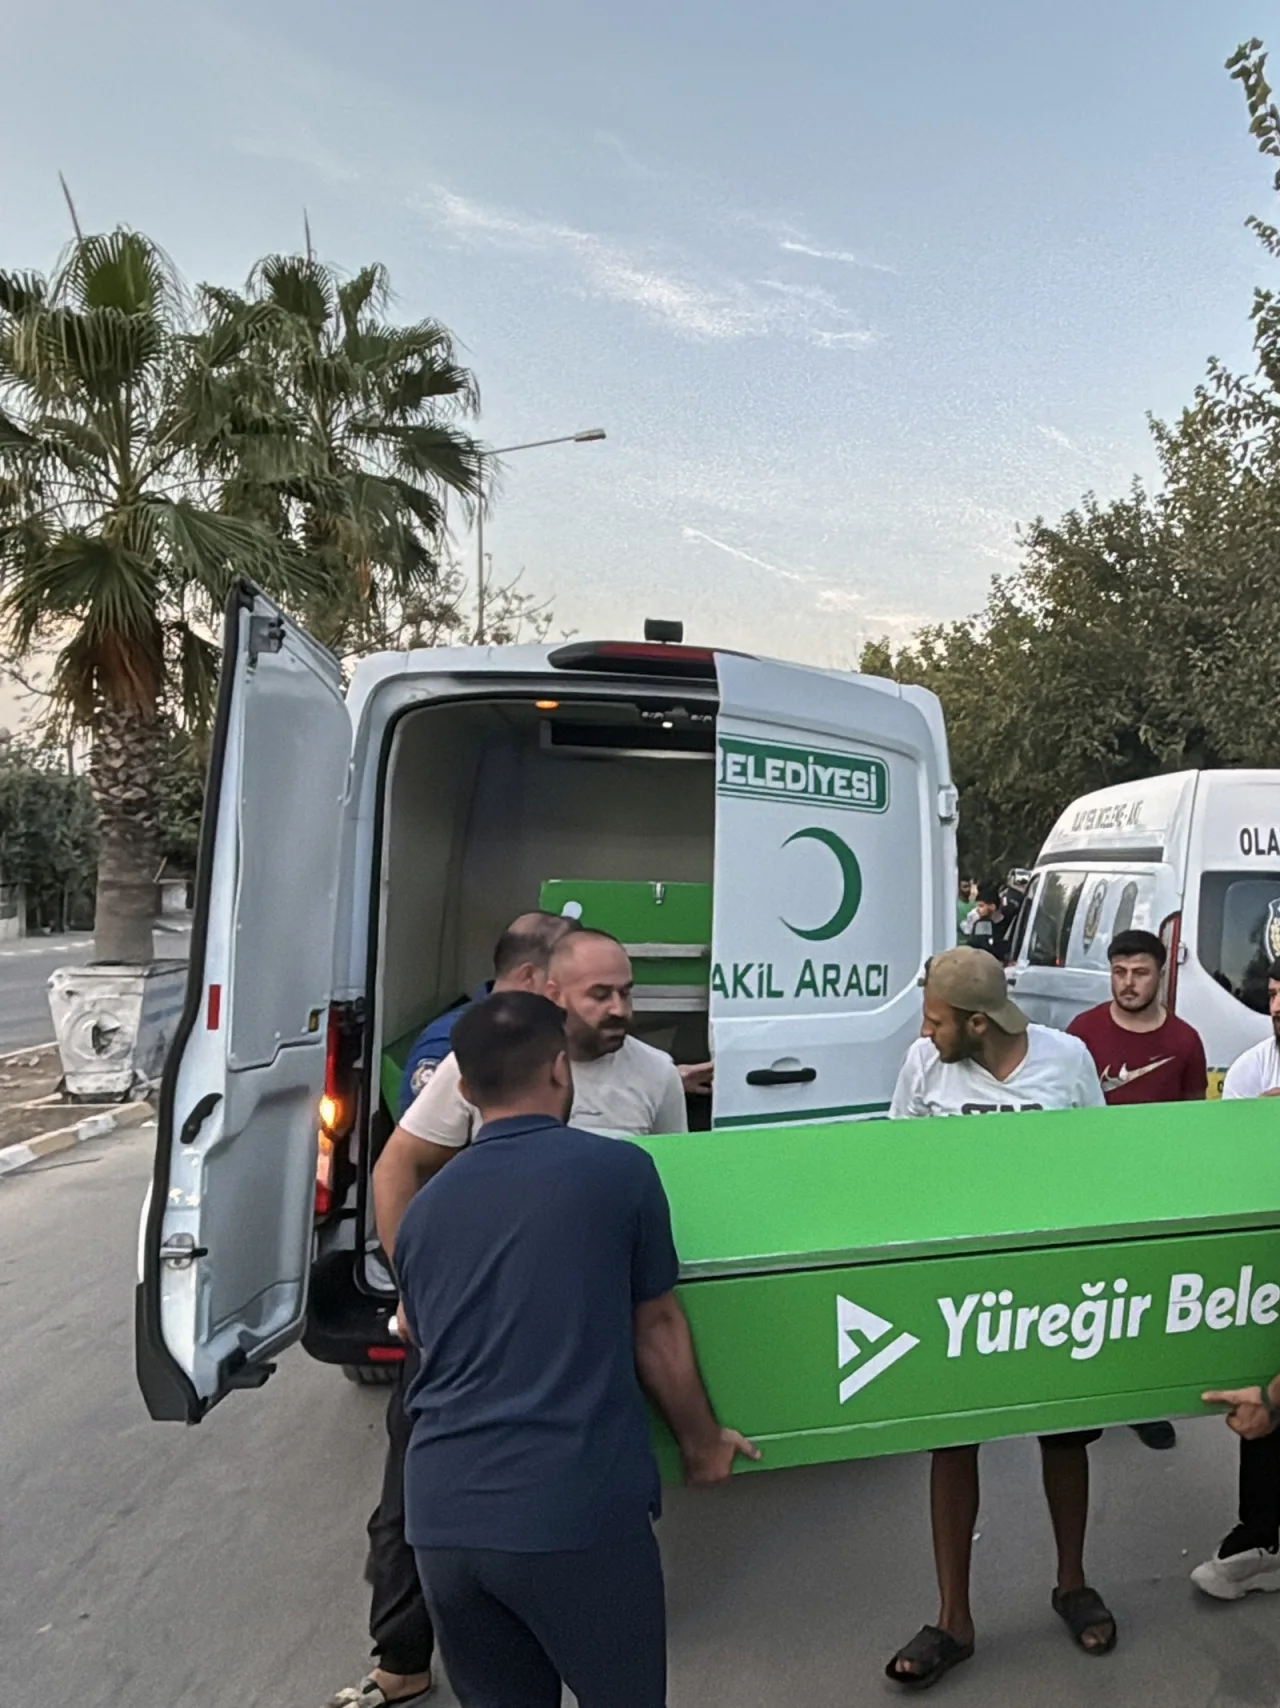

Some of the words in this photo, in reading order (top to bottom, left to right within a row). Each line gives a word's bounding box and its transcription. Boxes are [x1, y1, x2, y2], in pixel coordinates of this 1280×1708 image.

[718, 746, 878, 801] ELEDİYESİ
[793, 958, 889, 998] ARACI
[937, 1278, 1152, 1361] Yüreğir
